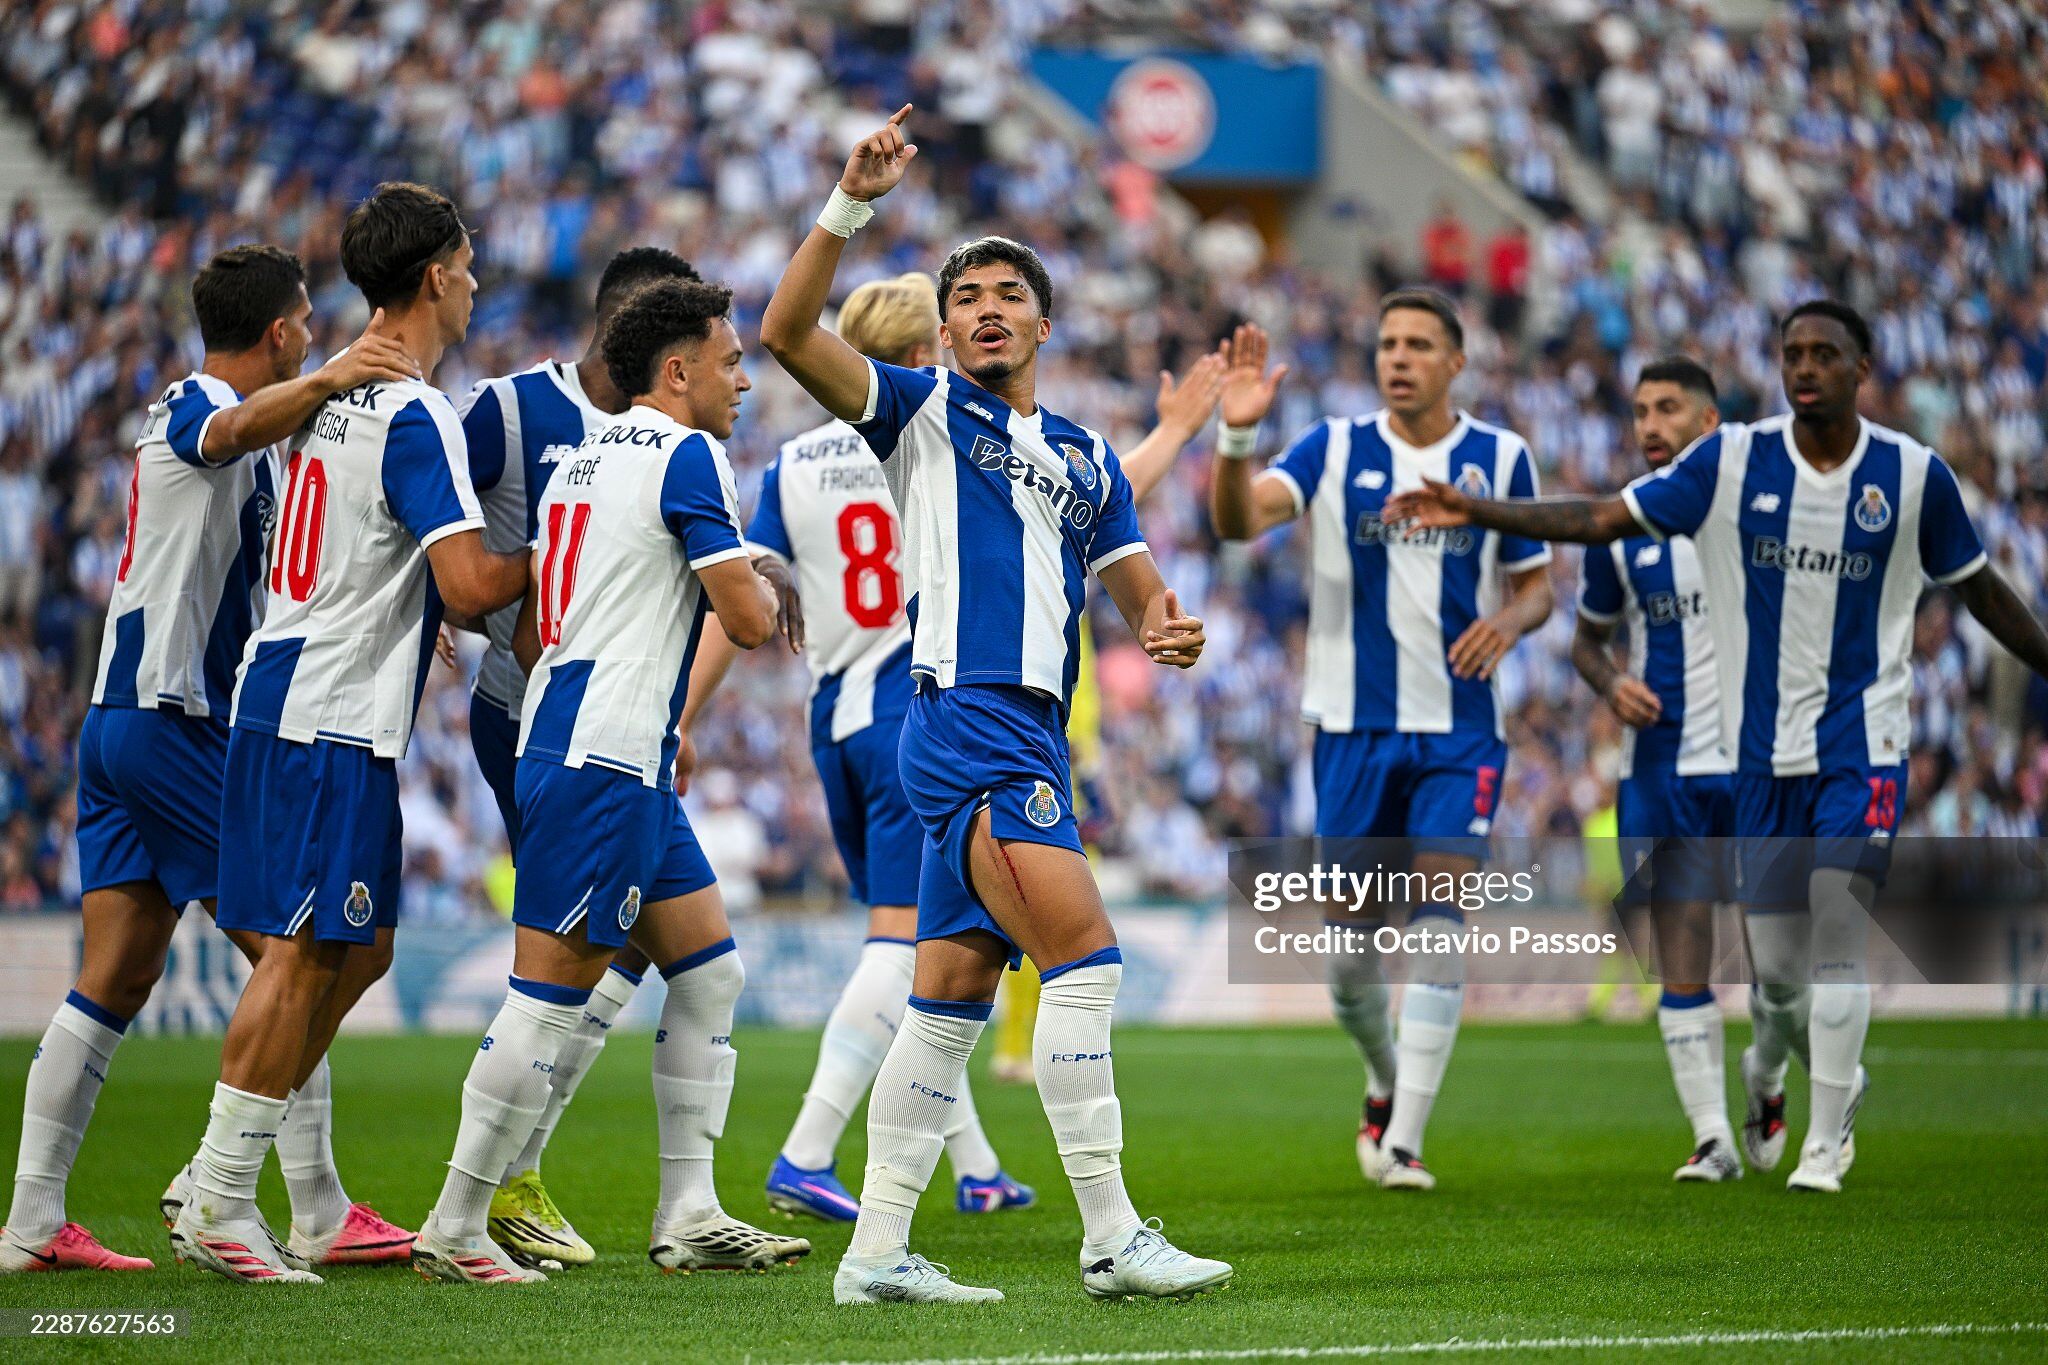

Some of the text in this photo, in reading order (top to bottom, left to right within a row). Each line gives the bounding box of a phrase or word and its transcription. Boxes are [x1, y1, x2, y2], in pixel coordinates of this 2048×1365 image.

[567, 455, 601, 486] PEPÊ
[599, 425, 673, 450] BOCK
[794, 434, 863, 462] SUPER
[970, 434, 1093, 530] Betano
[271, 450, 328, 603] 10
[1752, 535, 1873, 582] Betano
[539, 503, 592, 648] 11
[837, 501, 904, 630] 8
